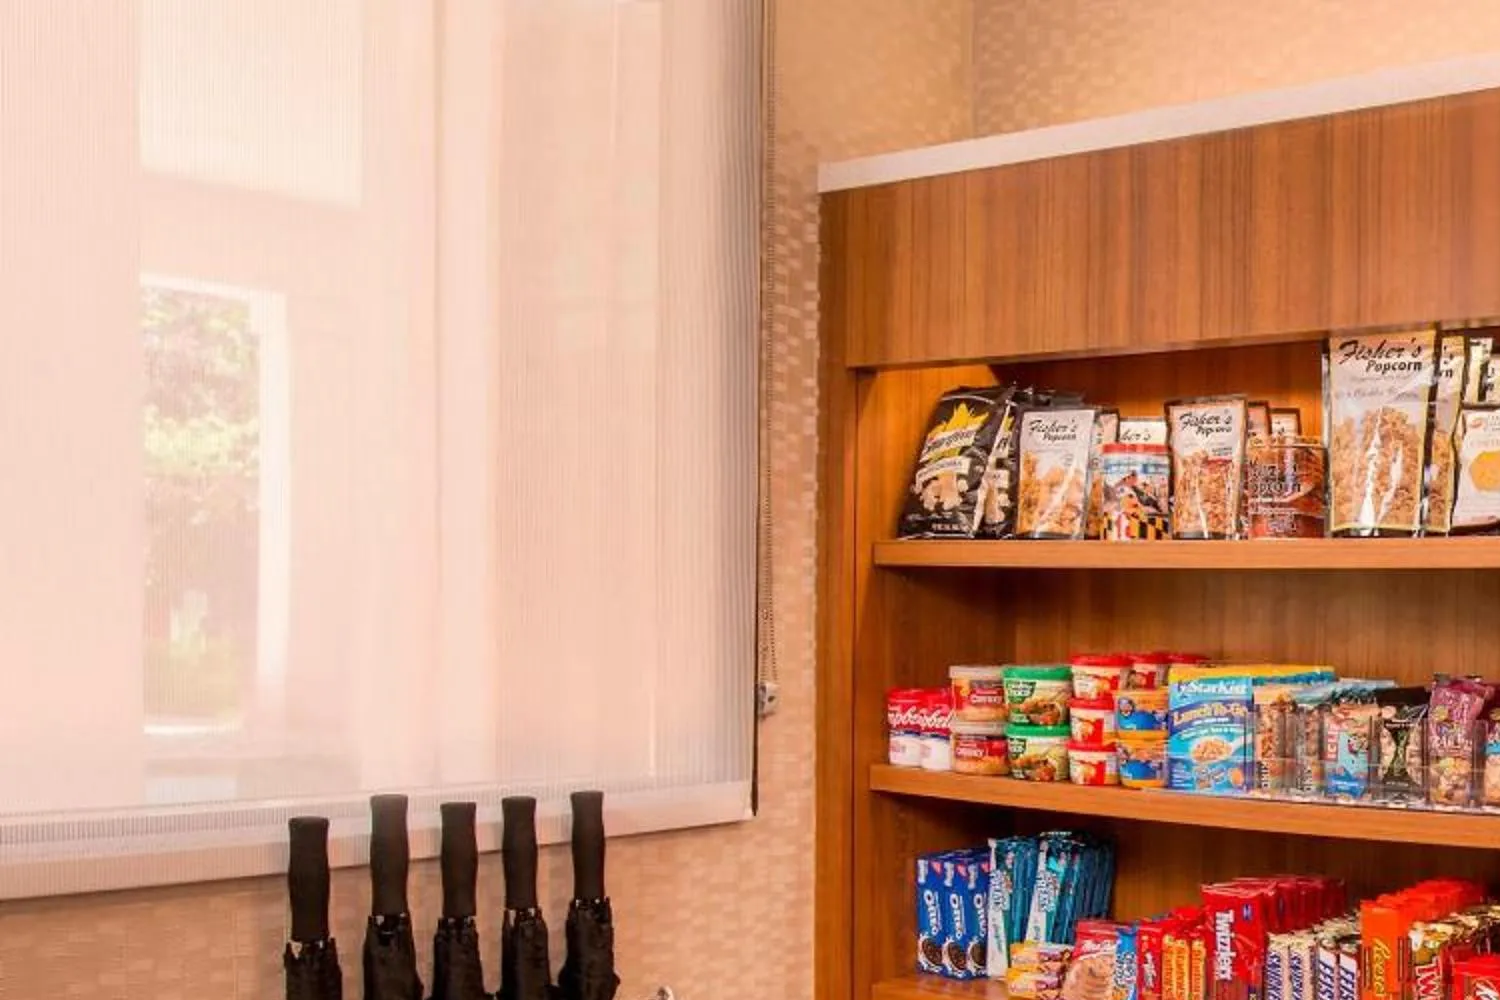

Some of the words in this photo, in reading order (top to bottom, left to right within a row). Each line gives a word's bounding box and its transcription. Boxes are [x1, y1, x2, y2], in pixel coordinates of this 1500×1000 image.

[1338, 337, 1422, 365] Fisher's
[1366, 359, 1423, 375] Popcorn
[1029, 418, 1078, 436] Fisher's
[1179, 409, 1233, 432] Fisher's
[1043, 432, 1077, 442] Popcorn
